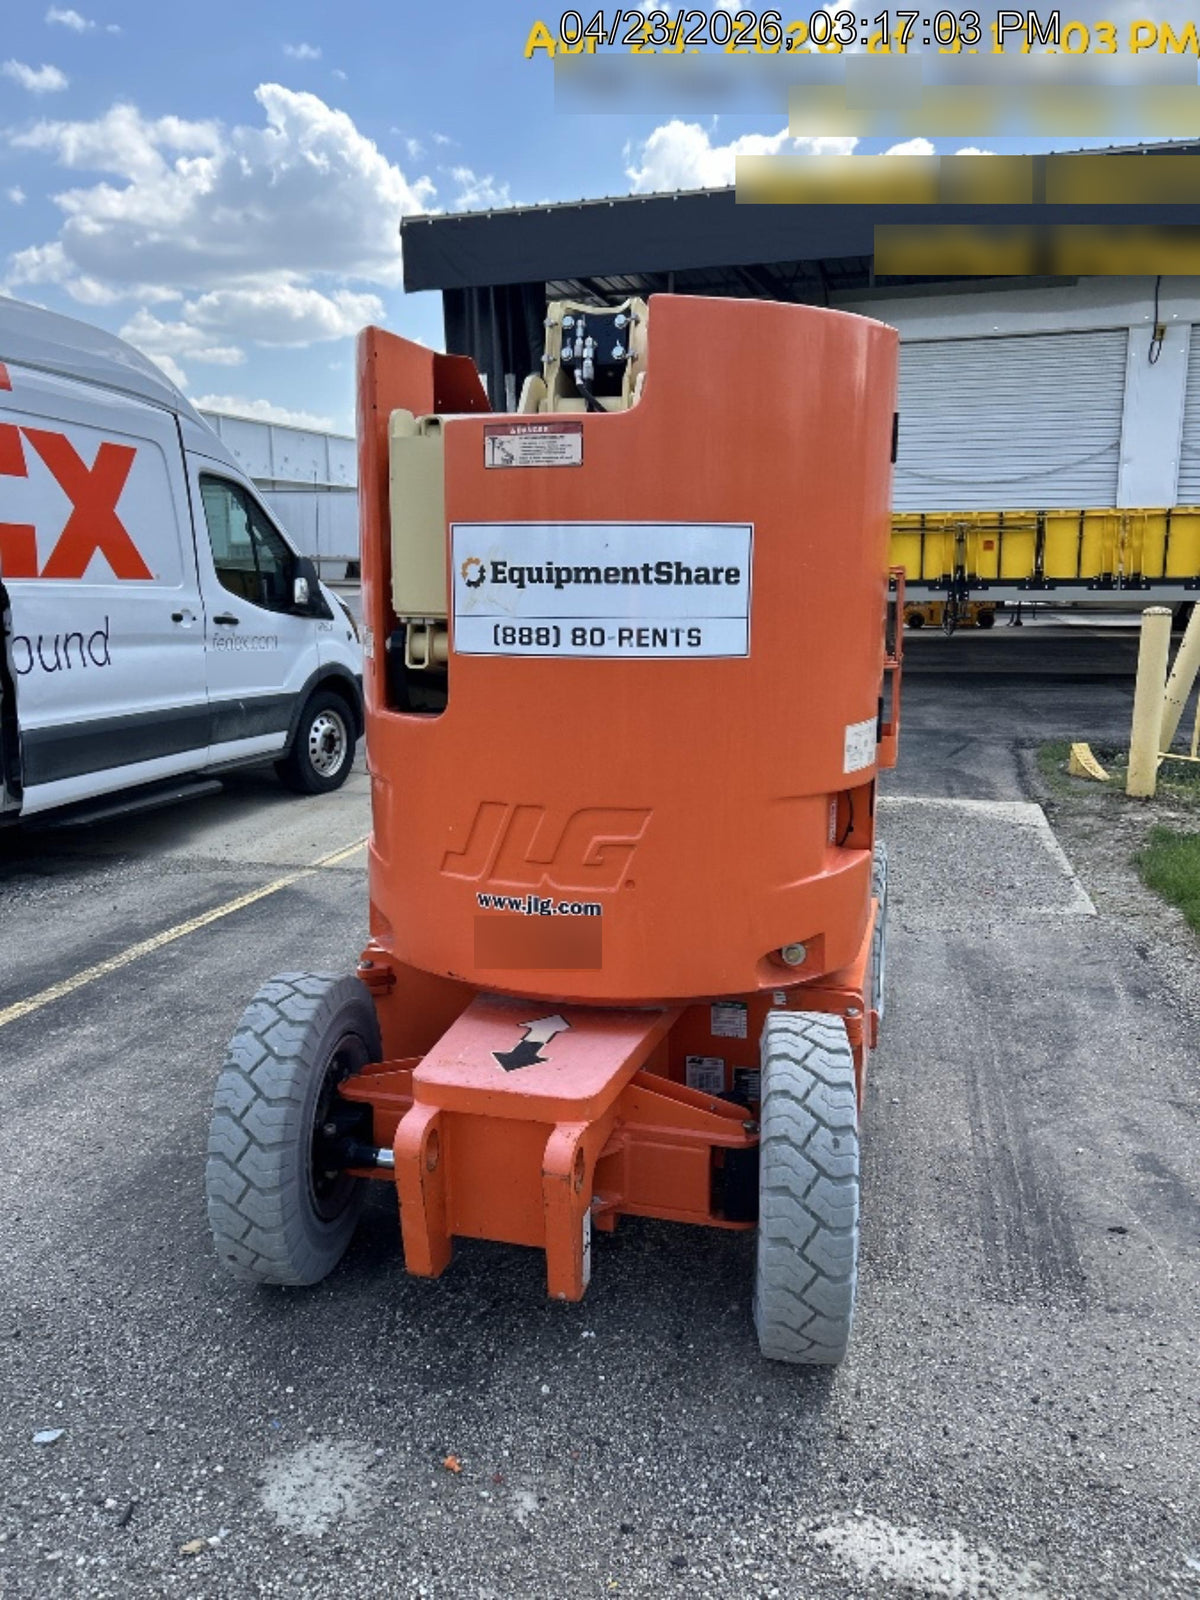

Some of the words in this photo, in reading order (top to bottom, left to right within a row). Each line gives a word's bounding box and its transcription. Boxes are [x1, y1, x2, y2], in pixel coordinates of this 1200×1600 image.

[490, 561, 741, 589] EquipmentShare
[493, 624, 561, 648] (888)
[571, 627, 702, 648] 80-RENTS
[440, 801, 653, 893] JLG
[476, 892, 603, 916] www.jlg.com
